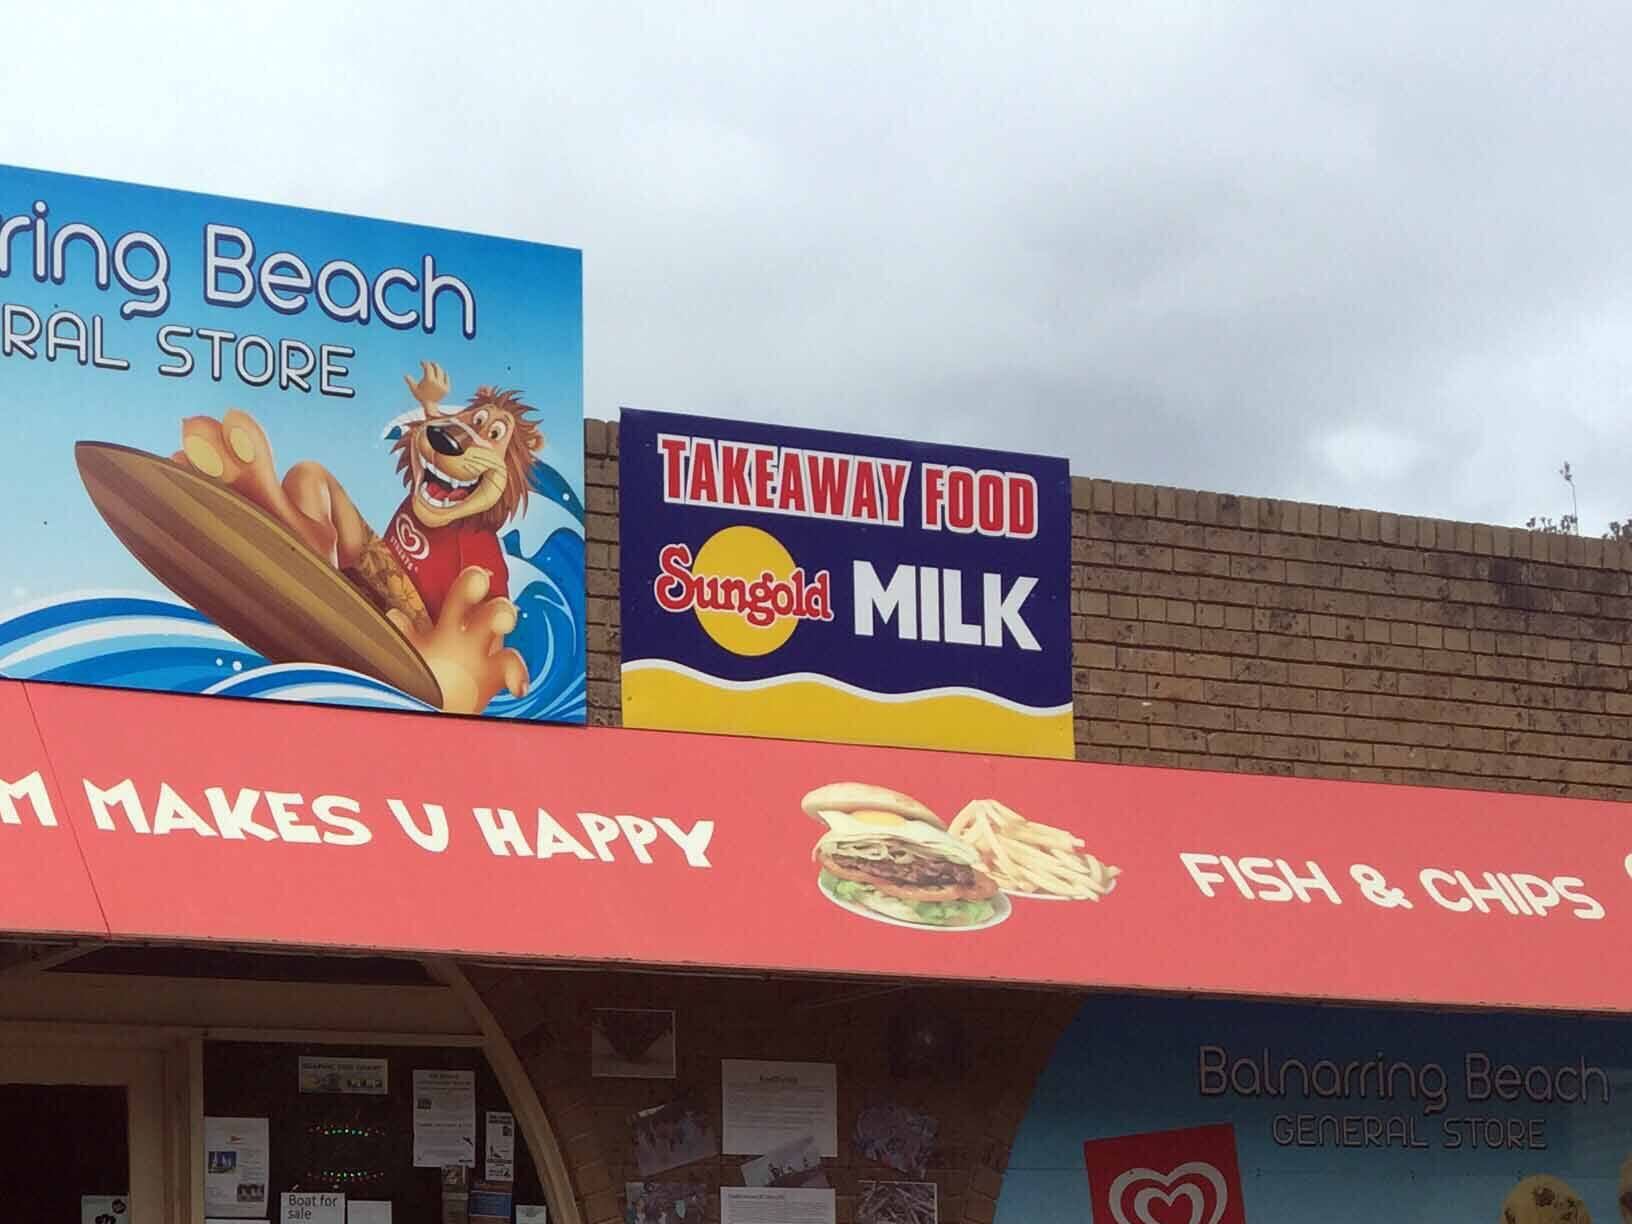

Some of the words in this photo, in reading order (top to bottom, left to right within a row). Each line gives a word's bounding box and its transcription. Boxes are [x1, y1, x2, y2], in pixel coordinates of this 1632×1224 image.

[203, 223, 476, 340] Beach
[158, 325, 356, 399] STORE
[657, 433, 912, 527] TAKEAWAY
[921, 462, 1038, 539] FOOD
[655, 543, 834, 628] Sungold
[853, 559, 1042, 651] MILK
[82, 778, 372, 845] MAKES
[386, 799, 449, 853] U
[472, 807, 715, 868] HAPPY
[1179, 852, 1342, 905] FISH
[1350, 862, 1413, 909] &
[1420, 867, 1606, 920] CHIPS
[1199, 1046, 1447, 1113] Balnarring
[1467, 1051, 1610, 1104] Beach
[1272, 1114, 1428, 1150] GENERAL
[1443, 1118, 1547, 1151] STORE
[288, 1194, 316, 1207] Boat
[320, 1194, 338, 1207] for
